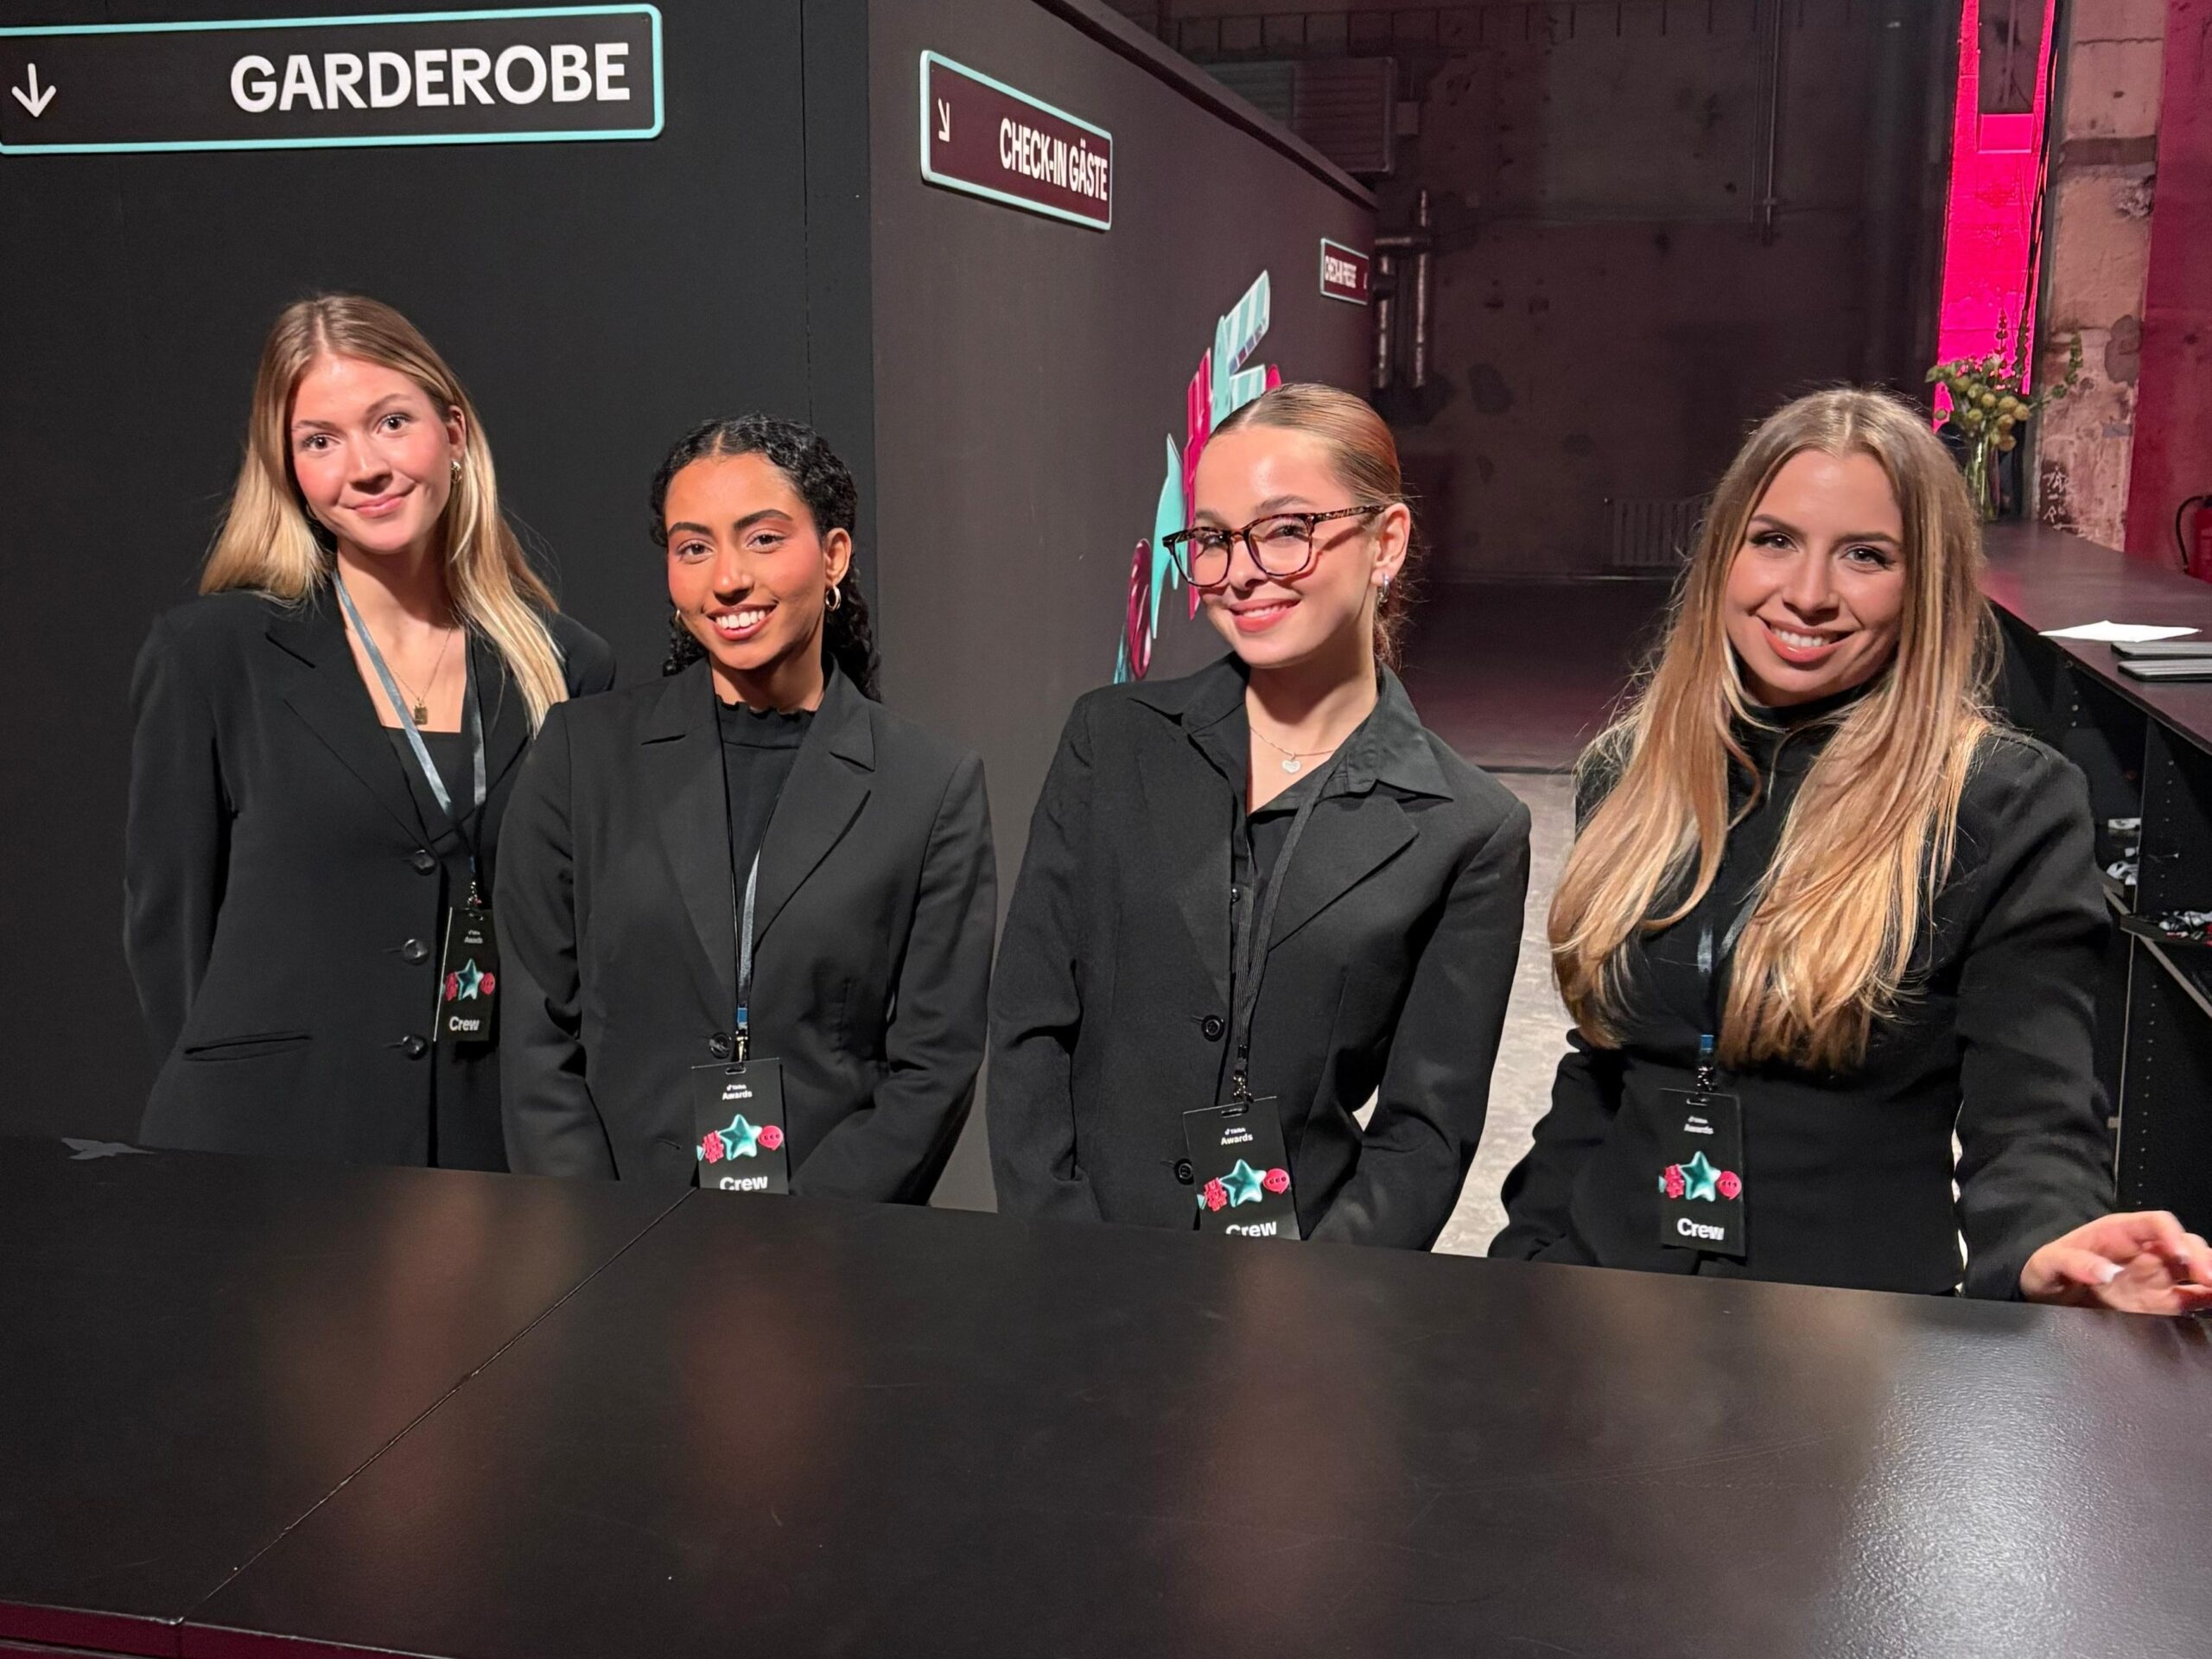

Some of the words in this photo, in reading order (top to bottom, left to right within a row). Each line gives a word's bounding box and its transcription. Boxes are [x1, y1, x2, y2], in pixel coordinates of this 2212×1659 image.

[230, 42, 631, 113] GARDEROBE
[1000, 118, 1067, 188] CHECK-IN
[1069, 137, 1108, 201] GÄSTE
[448, 1015, 480, 1032] Crew
[721, 1090, 753, 1101] Awards
[1221, 1133, 1254, 1146] Awards
[719, 1175, 769, 1192] Crew
[1225, 1221, 1277, 1237] Crew
[1676, 1217, 1726, 1241] Crew
